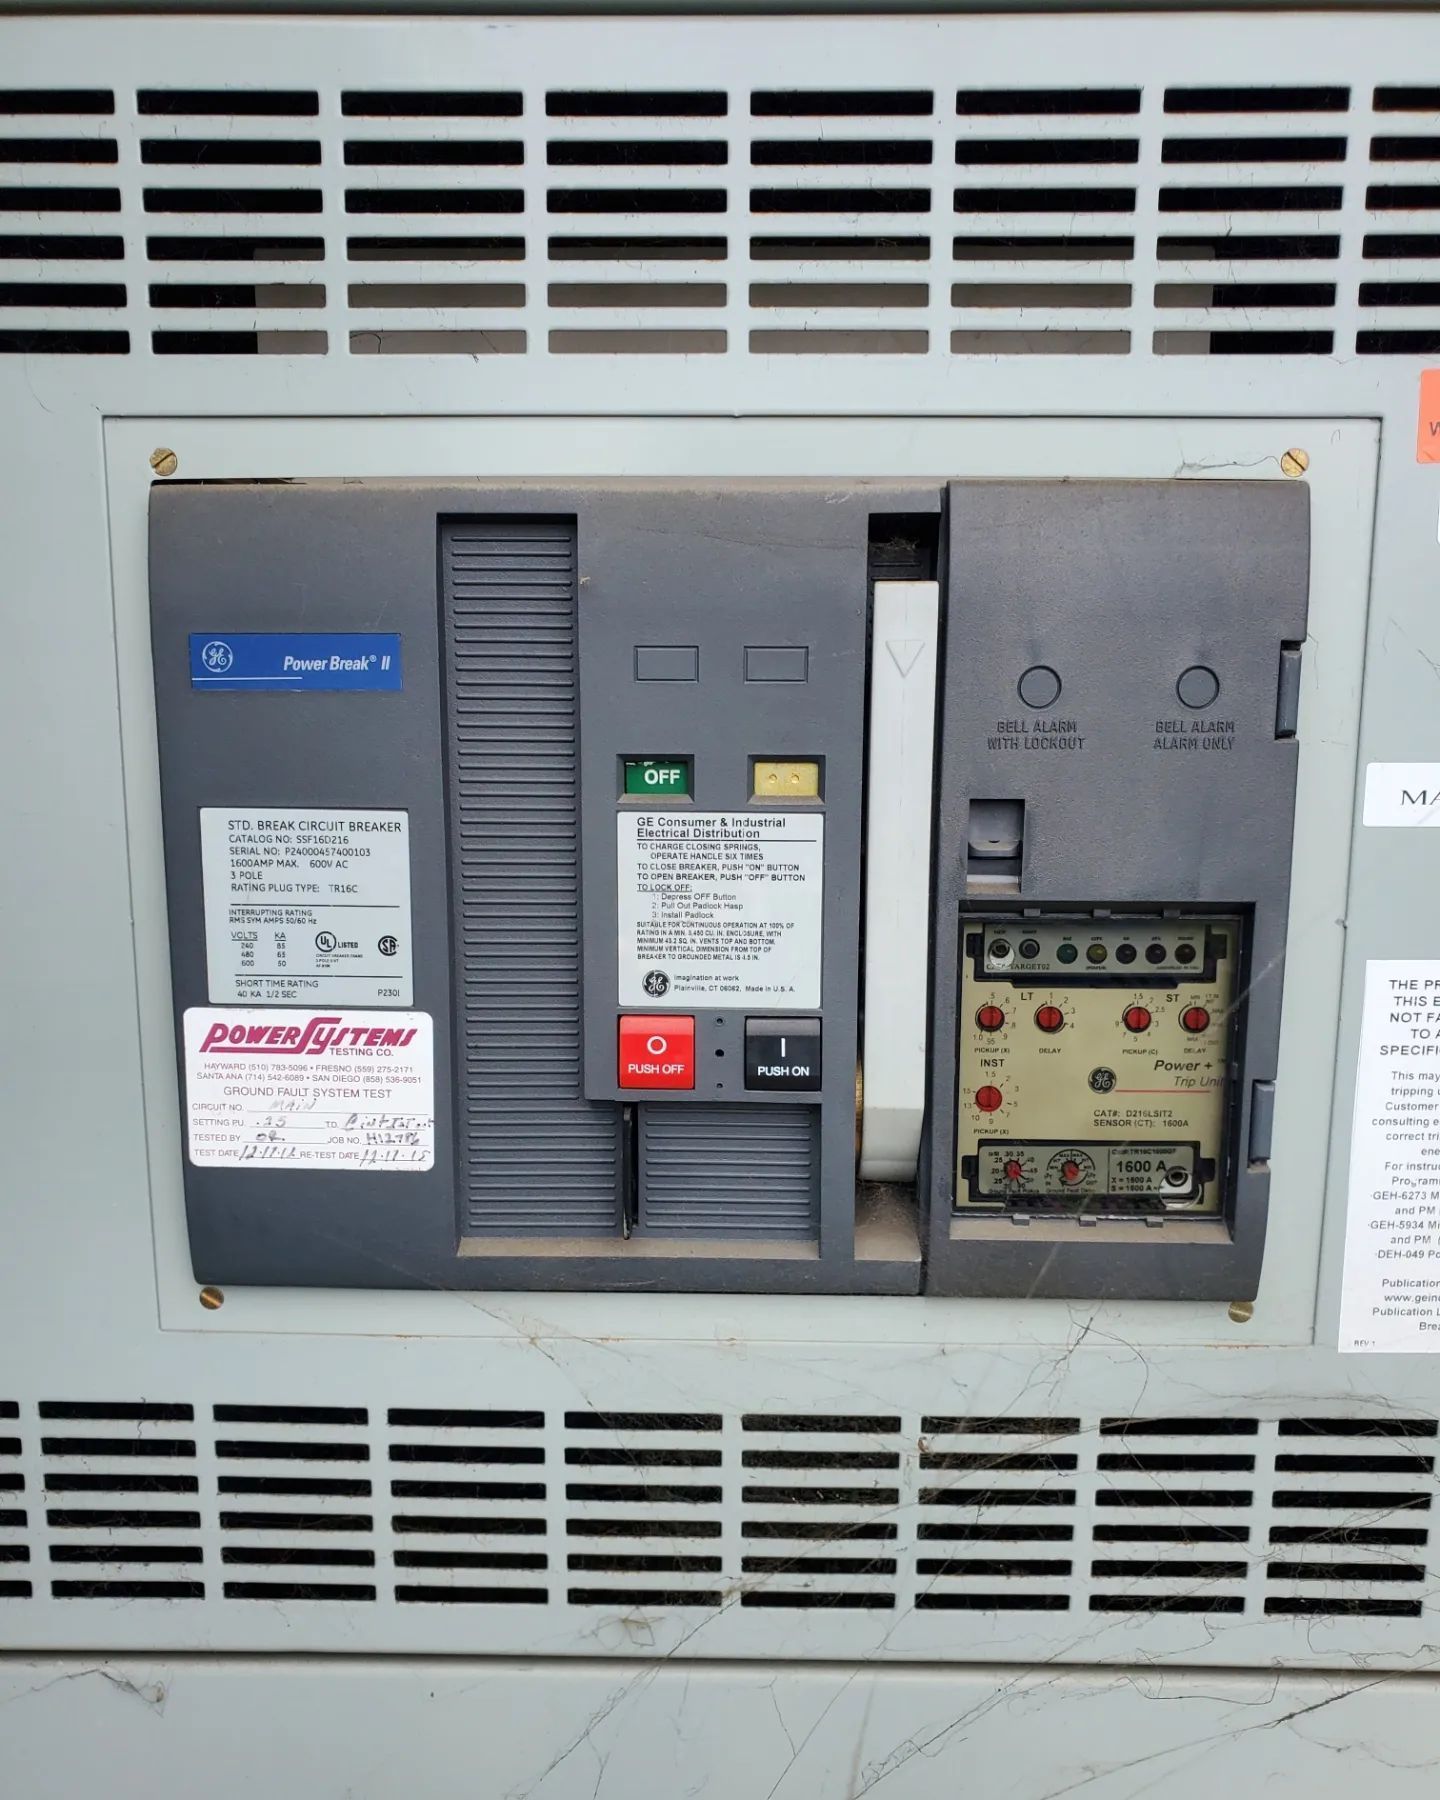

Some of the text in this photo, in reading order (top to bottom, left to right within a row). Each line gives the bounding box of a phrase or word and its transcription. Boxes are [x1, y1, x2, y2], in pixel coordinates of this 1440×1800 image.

[284, 656, 327, 671] Power
[381, 656, 390, 670] II
[997, 720, 1076, 733] BELL ALARM
[1156, 720, 1234, 733] BELL ALARM
[987, 737, 1085, 750] WITH LOCKOUT
[1153, 737, 1235, 750] ALARM ONLY
[644, 769, 680, 784] OFF
[228, 820, 401, 832] STD. BREAK CIRCUIT BREAKER
[637, 817, 785, 827] GE Consumer & Industrial
[637, 828, 760, 838] Electrical Distribution
[229, 835, 349, 844] CATALOG NO: SSF16D216
[229, 847, 260, 856] SERIAL
[264, 847, 280, 856] NO:
[724, 844, 760, 852] SPRINGS,
[231, 859, 348, 868] 1600AMP MAX. 600V AC
[231, 871, 263, 880] 3 POLE
[231, 884, 358, 893] RATING PLUG TYPE: TR16C
[662, 893, 691, 902] Depress
[724, 903, 743, 911] Hasp
[1389, 980, 1418, 990] THE
[1394, 996, 1427, 1006] THIS
[1390, 1012, 1422, 1022] NOT
[1411, 1029, 1430, 1039] TO
[330, 1048, 373, 1056] TESTING
[1380, 1045, 1440, 1056] SPECIFI
[981, 1059, 1005, 1067] INST
[1154, 1060, 1200, 1071] Power
[628, 1064, 684, 1074] PUSH OFF
[758, 1067, 809, 1076] PUSH ON
[196, 1072, 223, 1080] SANTA
[1392, 1071, 1414, 1080] This
[1174, 1076, 1224, 1088] Trip Unit
[224, 1086, 392, 1098] GROUND FAULT SYSTEM TEST
[1391, 1087, 1434, 1097] tripping
[1386, 1102, 1439, 1111] Customer
[1372, 1117, 1429, 1128] consulting
[300, 1151, 336, 1160] RE-TEST
[1116, 1160, 1166, 1172] 1600 A
[1395, 1206, 1435, 1215] and PM
